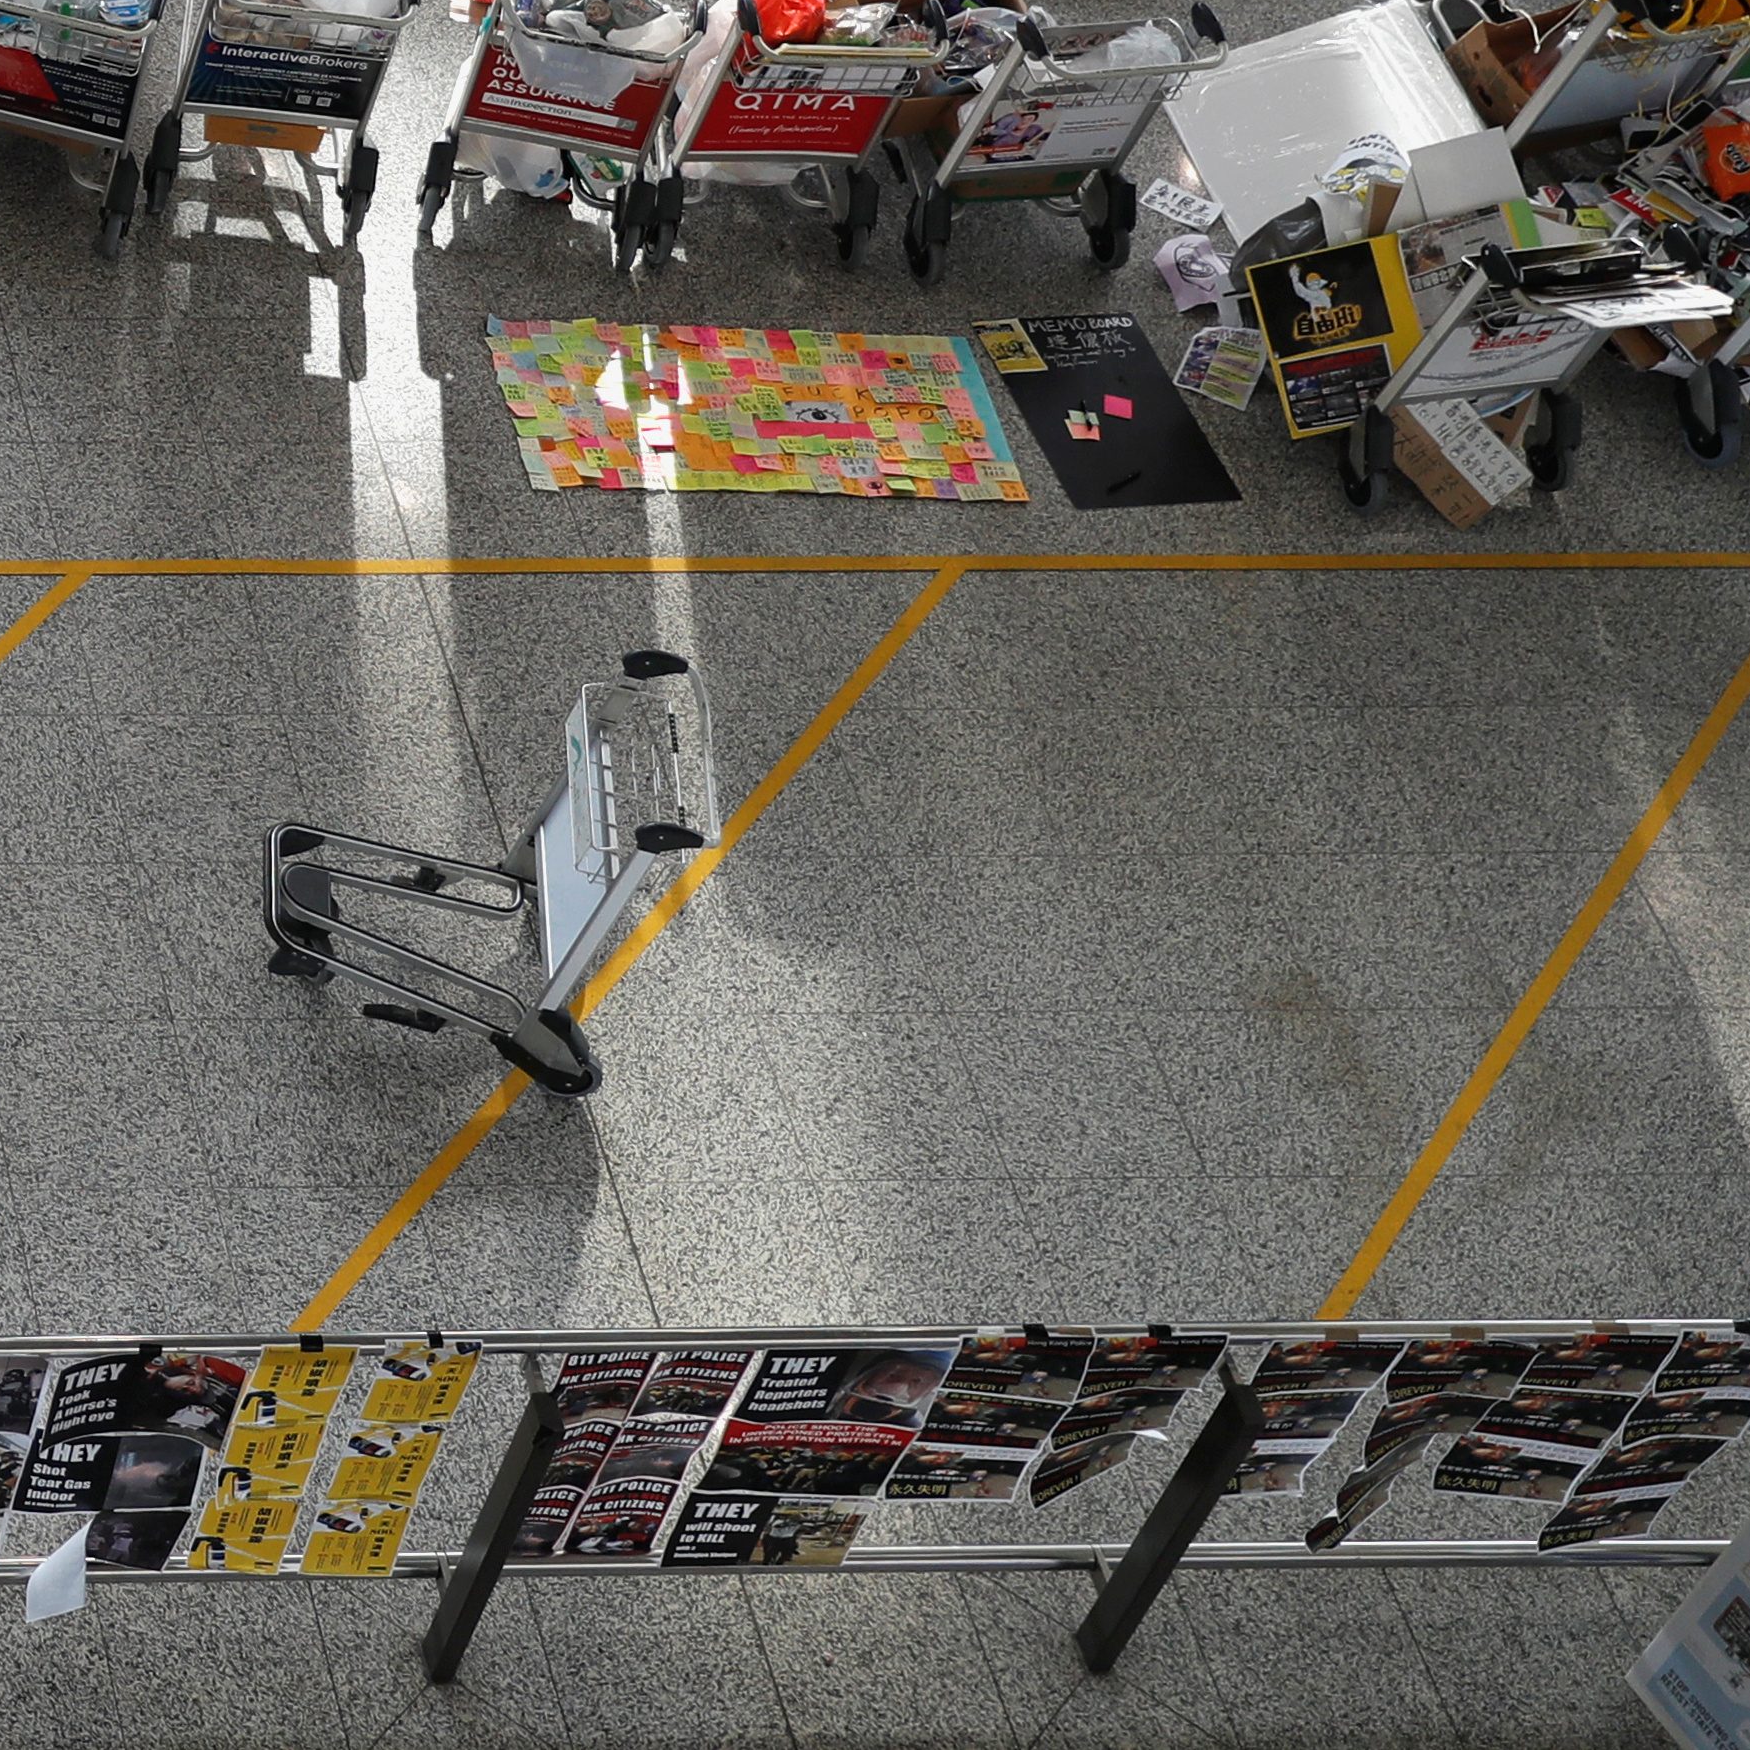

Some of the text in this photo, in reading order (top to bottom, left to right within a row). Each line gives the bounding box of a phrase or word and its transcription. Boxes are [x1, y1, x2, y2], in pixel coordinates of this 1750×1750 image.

[221, 43, 368, 72] InteractiveBrokers
[734, 93, 856, 112] QIMA
[1028, 317, 1133, 333] MEMO BOARD
[782, 387, 870, 400] FUCK
[853, 407, 935, 420] POPO
[769, 1357, 837, 1374] THEY
[64, 1363, 127, 1391] THEY
[760, 1375, 818, 1389] Treated
[58, 1389, 91, 1408] Took
[753, 1387, 828, 1402] Reporters
[65, 1398, 118, 1420] nurse's
[748, 1398, 826, 1411] headshots
[51, 1410, 115, 1434] Right eye
[33, 1463, 66, 1477] Shot
[30, 1476, 92, 1490] Tear Gas
[888, 1482, 948, 1496] 永久失明
[1437, 1475, 1498, 1491] 永久失明
[26, 1489, 75, 1502] Indoor
[694, 1503, 760, 1519] THEY
[685, 1521, 757, 1533] will shoot
[697, 1533, 725, 1544] KILL
